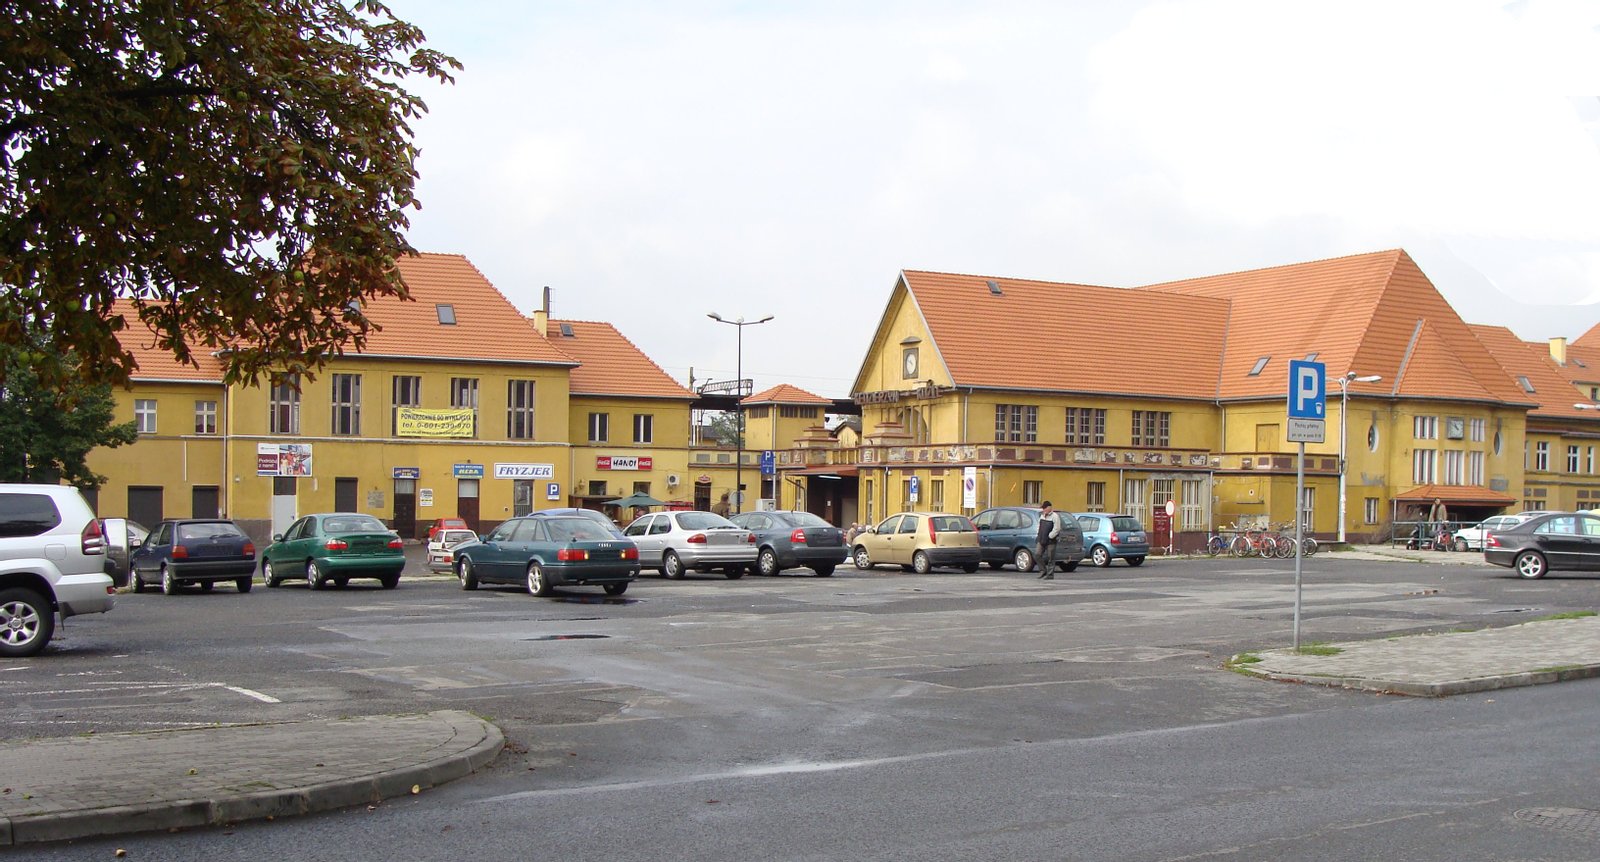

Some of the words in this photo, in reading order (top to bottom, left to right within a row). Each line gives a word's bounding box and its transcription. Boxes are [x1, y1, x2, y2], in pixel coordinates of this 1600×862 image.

[1297, 367, 1318, 411] P
[613, 459, 637, 467] HANOI
[499, 466, 551, 475] FRYZJER
[550, 484, 558, 495] P
